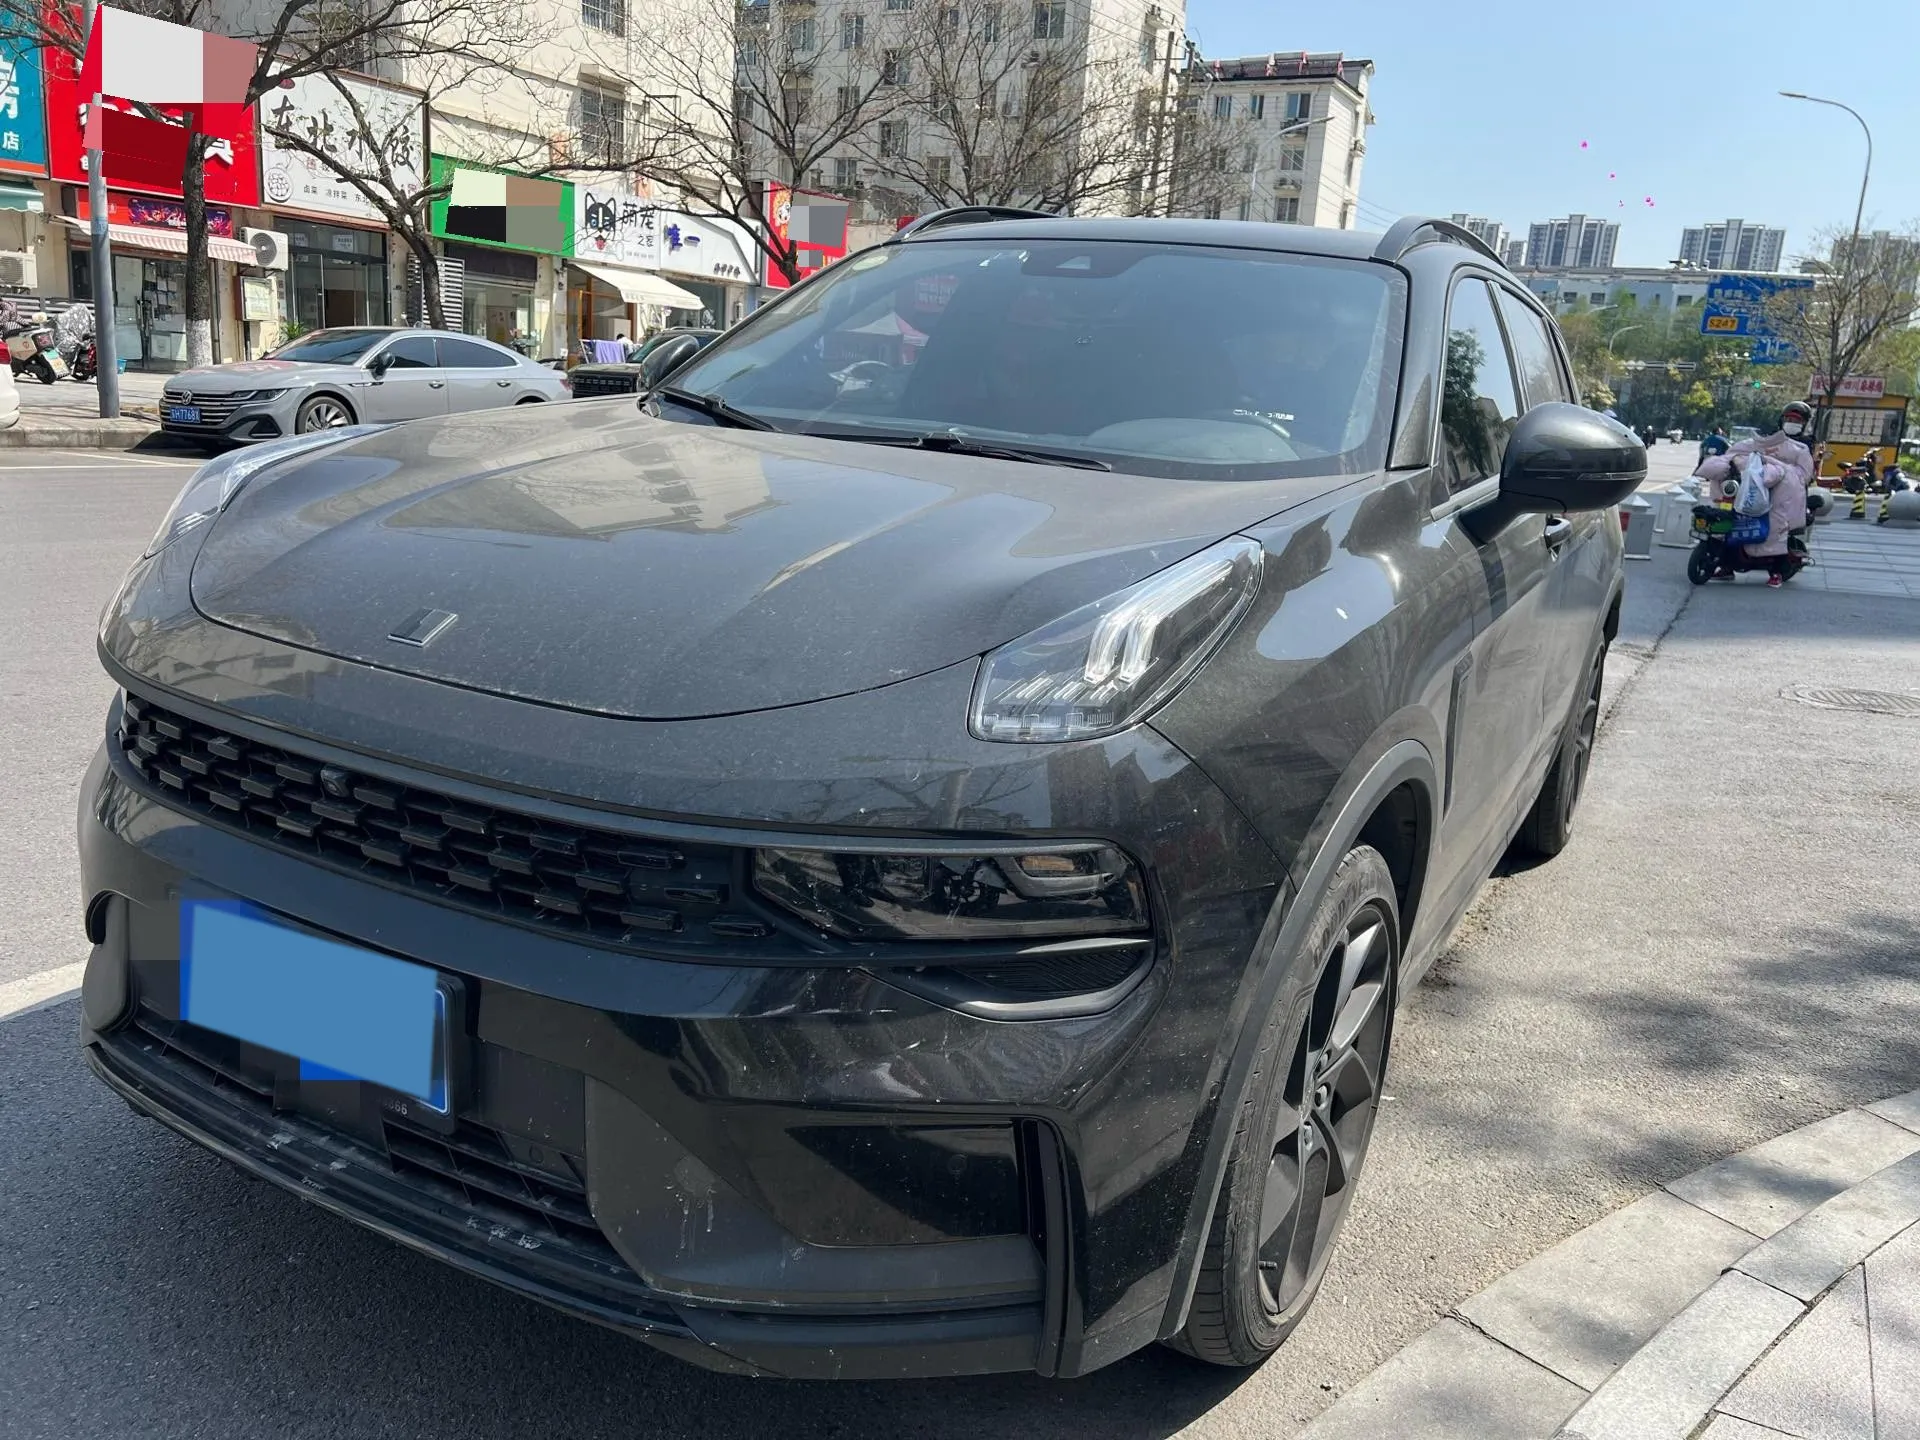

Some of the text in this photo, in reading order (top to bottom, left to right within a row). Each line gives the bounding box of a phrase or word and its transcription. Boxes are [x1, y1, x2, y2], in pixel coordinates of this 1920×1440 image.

[2, 131, 20, 151] 店
[622, 201, 655, 230] 萌宠
[637, 234, 655, 248] 之家
[1709, 319, 1736, 329] S247
